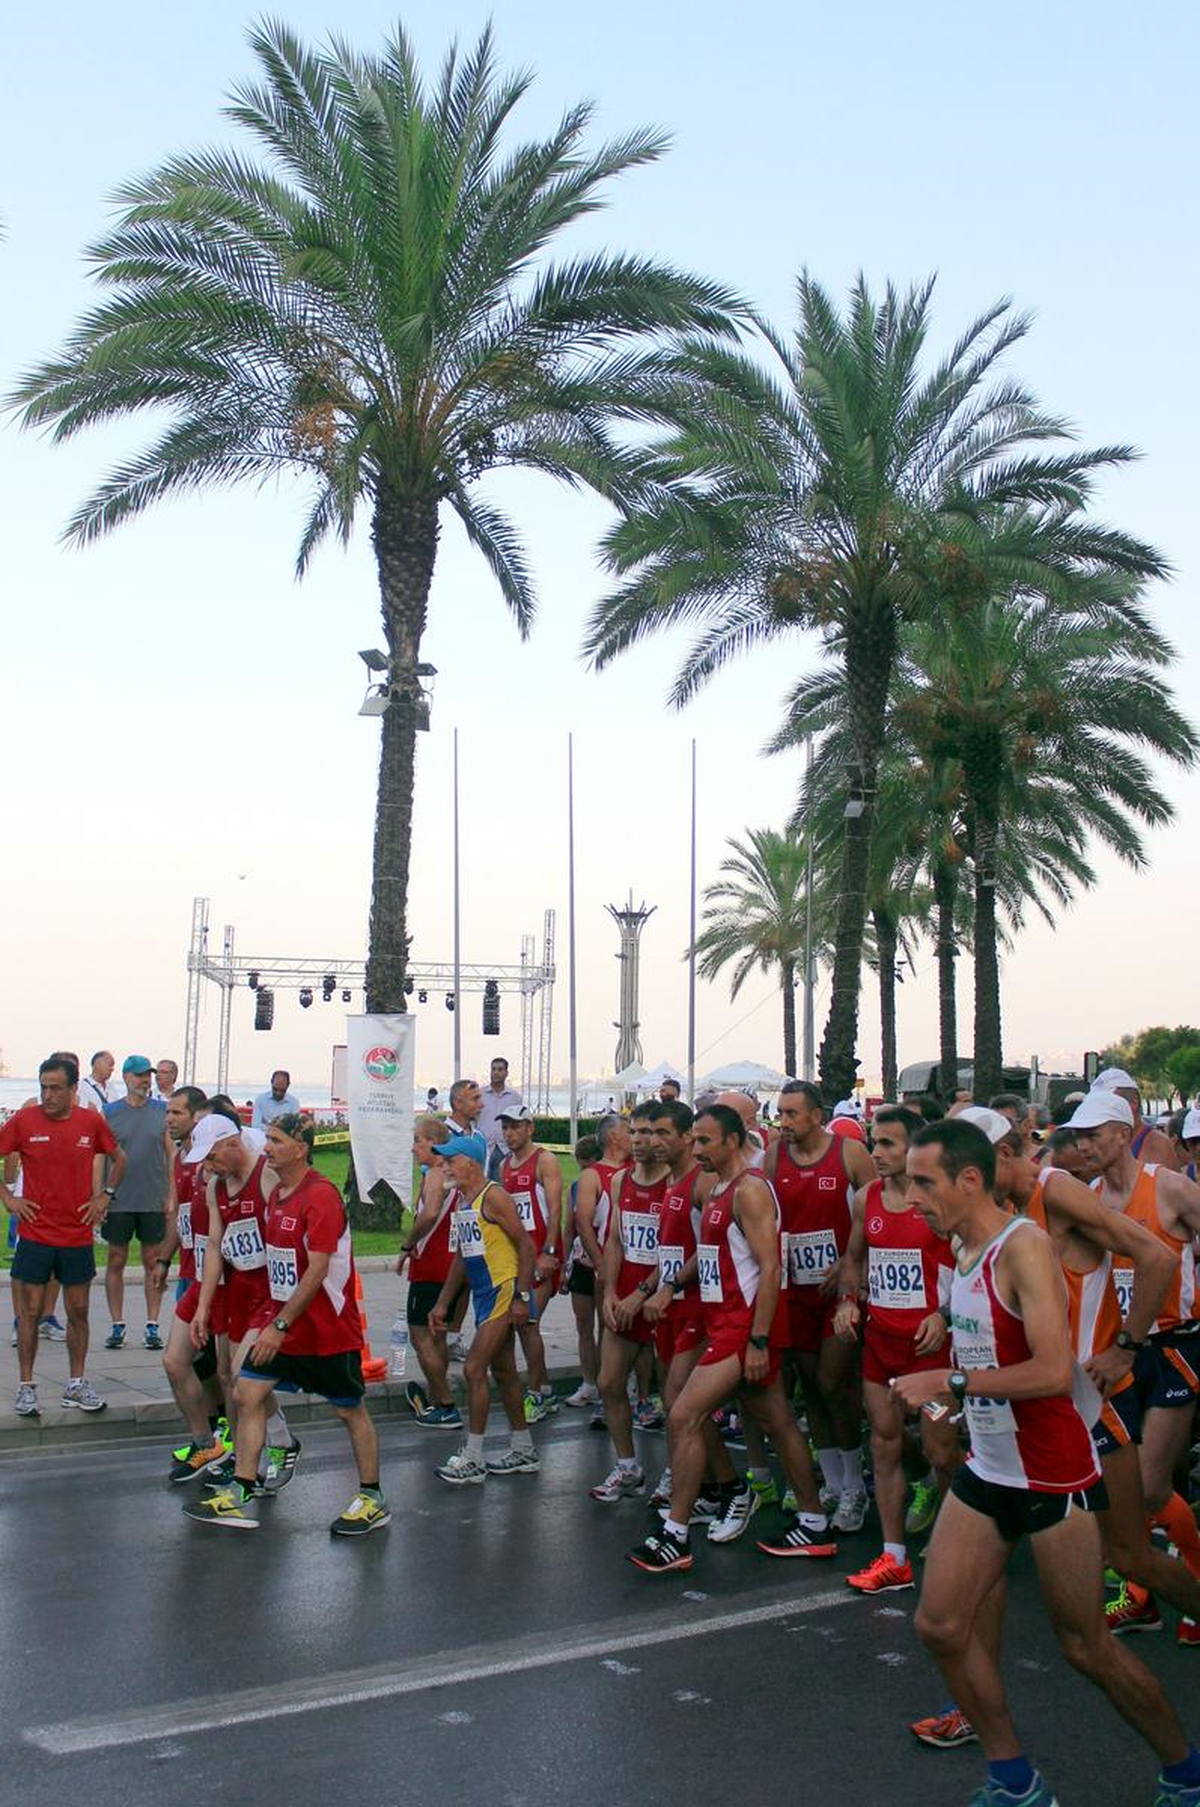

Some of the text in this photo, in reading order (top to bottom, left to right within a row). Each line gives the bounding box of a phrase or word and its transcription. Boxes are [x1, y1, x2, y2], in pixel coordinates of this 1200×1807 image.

[229, 1230, 263, 1257] 1831
[629, 1225, 661, 1250] 178
[794, 1243, 837, 1269] 1879
[878, 1263, 923, 1291] 1982
